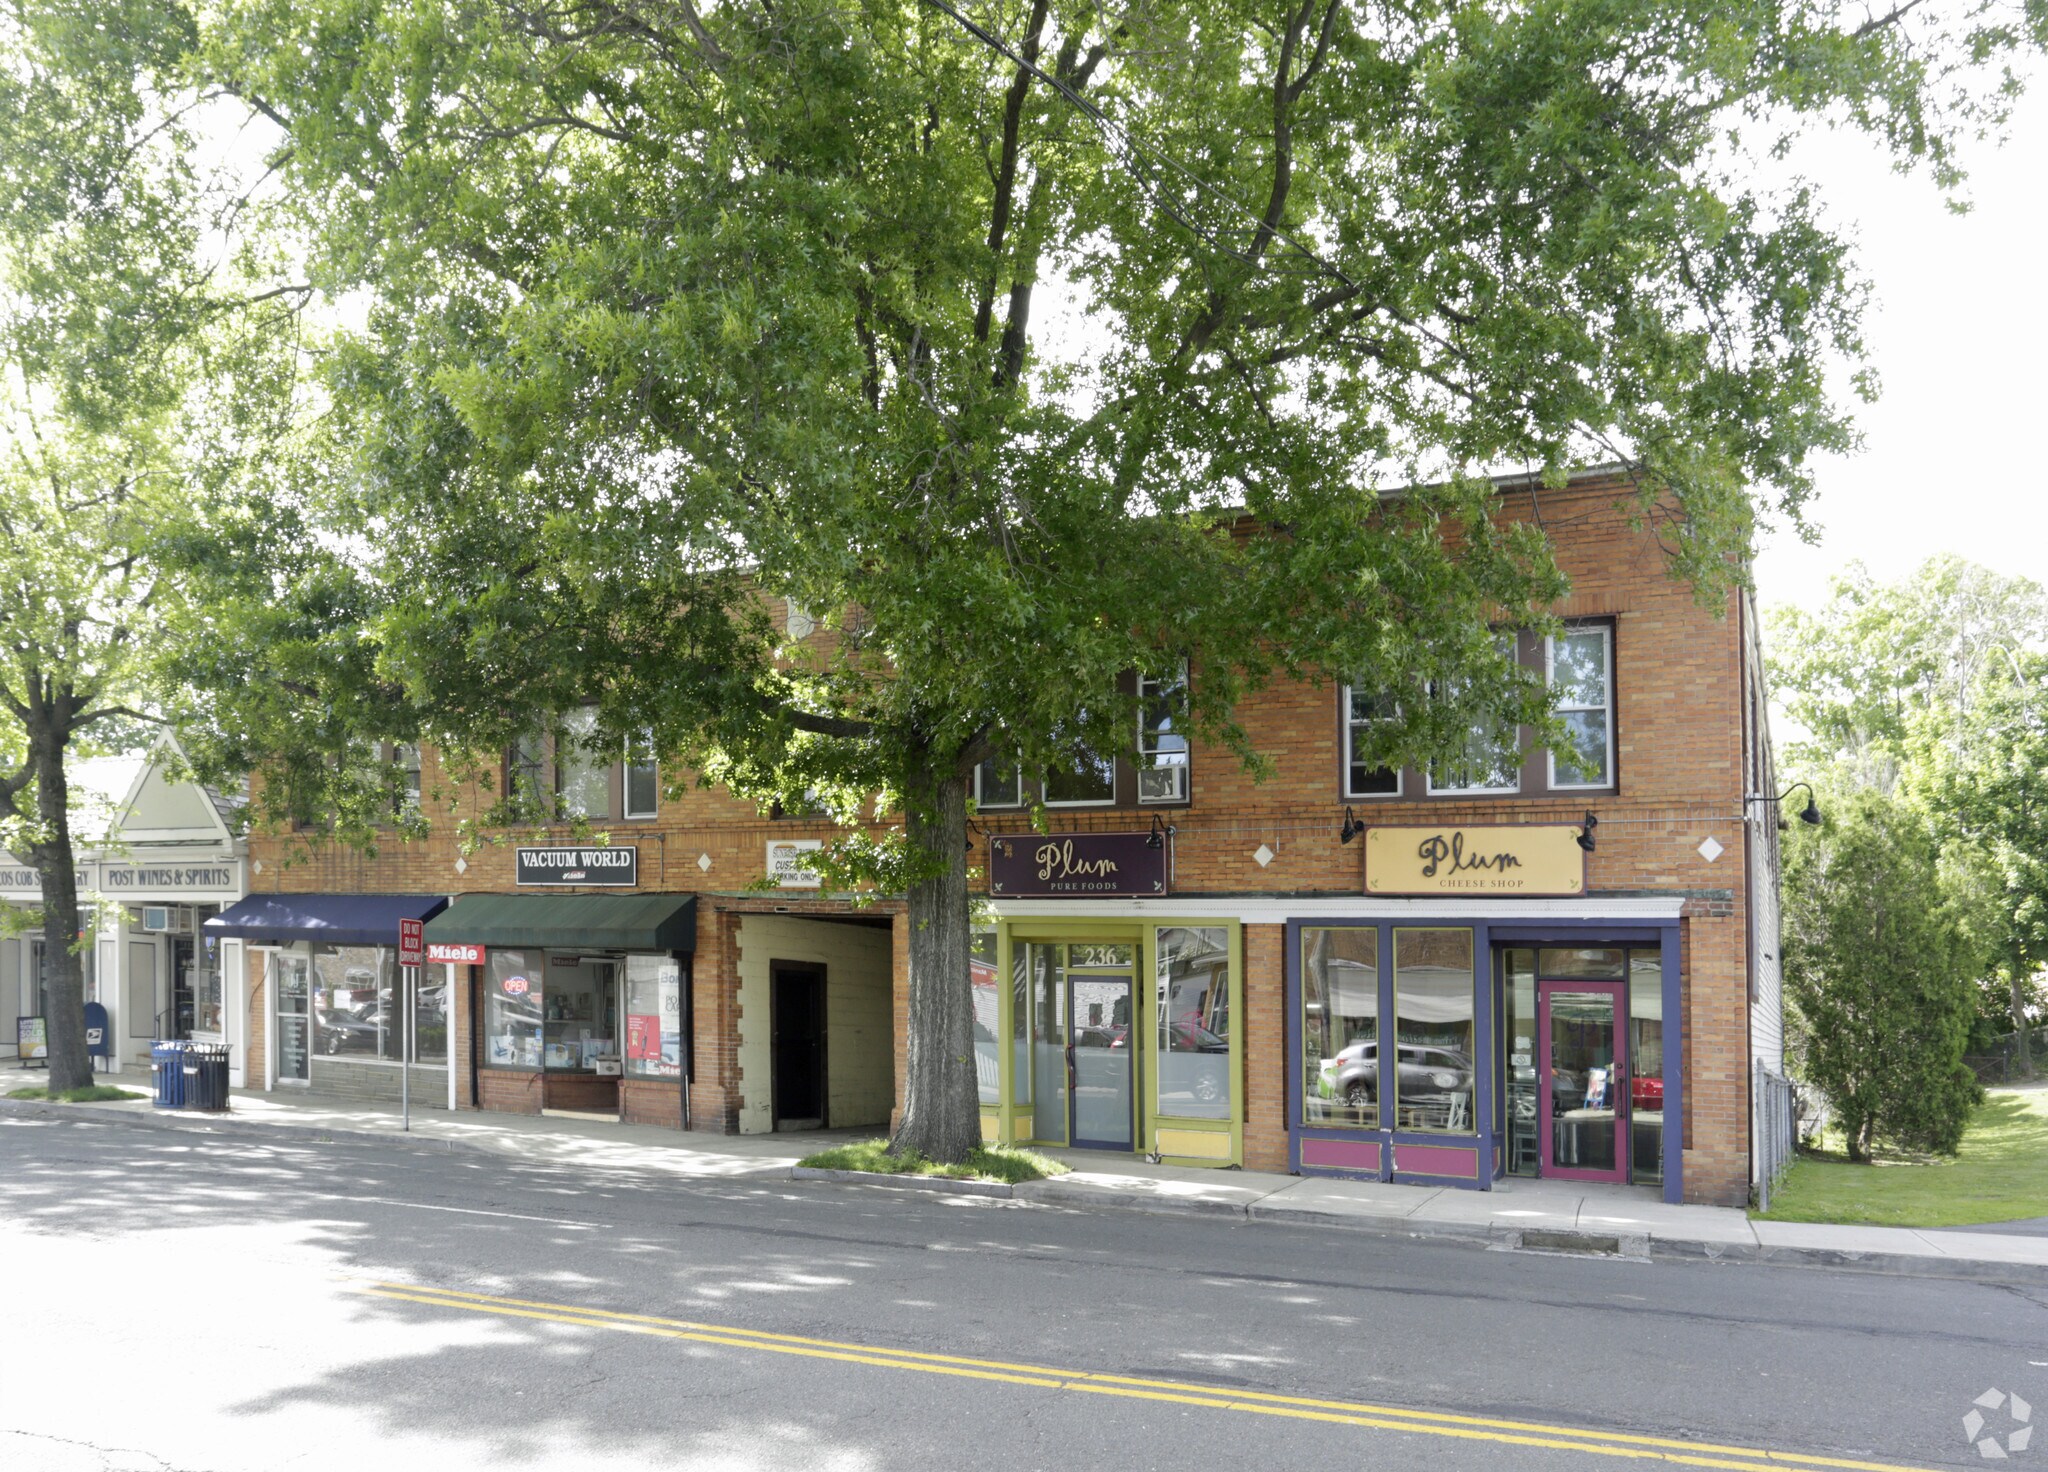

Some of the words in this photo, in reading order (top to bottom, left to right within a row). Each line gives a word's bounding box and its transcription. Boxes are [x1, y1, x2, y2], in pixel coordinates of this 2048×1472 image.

[521, 851, 578, 867] VACUUM
[580, 851, 631, 867] WORLD
[1035, 839, 1119, 881] Plum
[1419, 832, 1523, 878] Plum
[15, 871, 33, 886] COB
[108, 869, 135, 886] POST
[138, 869, 173, 886] WINES
[174, 868, 183, 885] &
[185, 868, 230, 886] SPIRITS
[770, 872, 798, 881] PRKING
[800, 872, 816, 881] ONLY
[1439, 880, 1486, 888] CHEESE
[1490, 880, 1524, 888] SHOP
[1050, 882, 1077, 890] PURE
[1081, 882, 1117, 890] FOODS
[403, 922, 411, 934] DO
[411, 923, 420, 935] NOT
[404, 937, 419, 949] BLOCK
[429, 945, 478, 960] Miele
[1085, 948, 1117, 965] 236
[504, 980, 528, 992] OPEN
